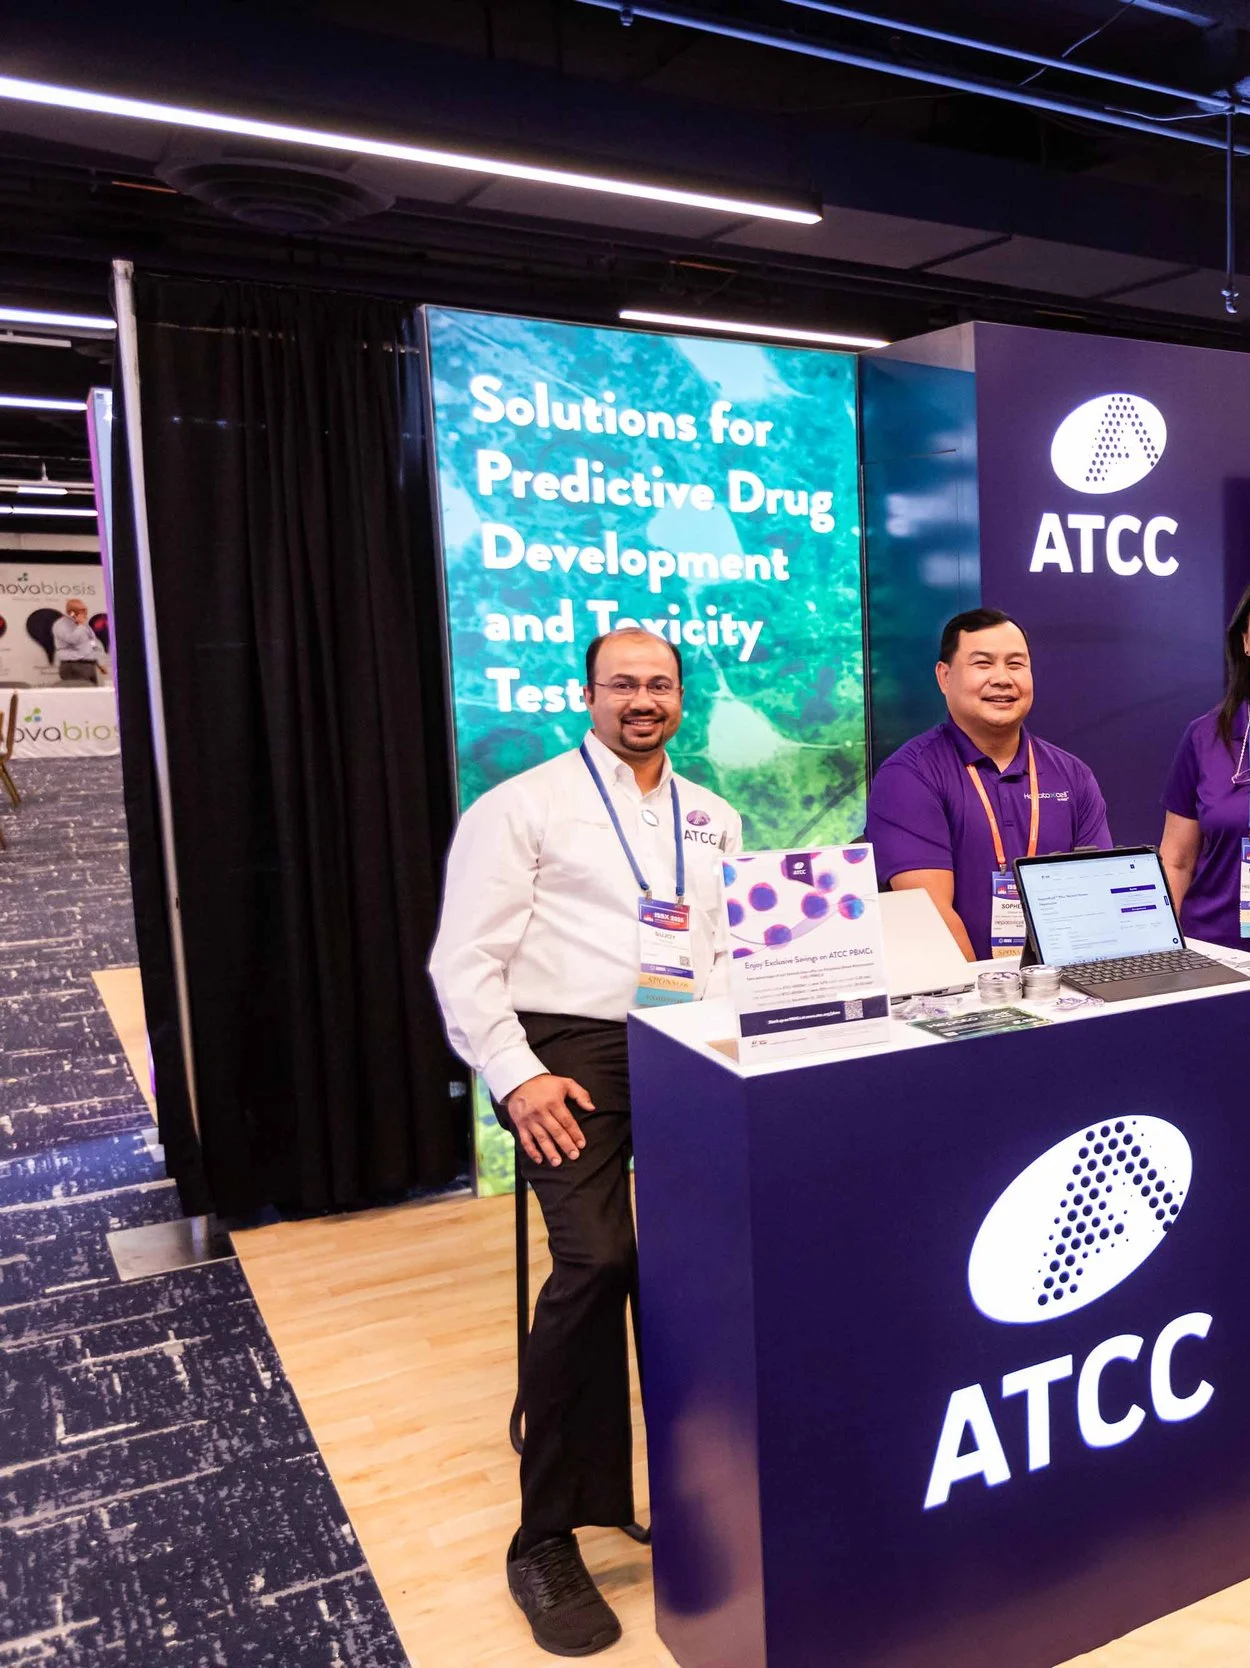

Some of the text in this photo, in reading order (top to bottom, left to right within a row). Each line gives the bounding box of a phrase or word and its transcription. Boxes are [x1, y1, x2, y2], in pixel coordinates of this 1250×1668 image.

[470, 374, 773, 447] Solutions for
[476, 450, 835, 533] Predictive Drug
[481, 523, 789, 593] Development
[1029, 513, 1180, 577] ATCC
[483, 600, 574, 642] and
[485, 667, 587, 713] Test
[684, 829, 717, 845] ATCC
[745, 962, 763, 970] Enjoy
[765, 959, 793, 967] Exclusive
[795, 956, 818, 964] Savings
[923, 1312, 1214, 1510] ATCC
